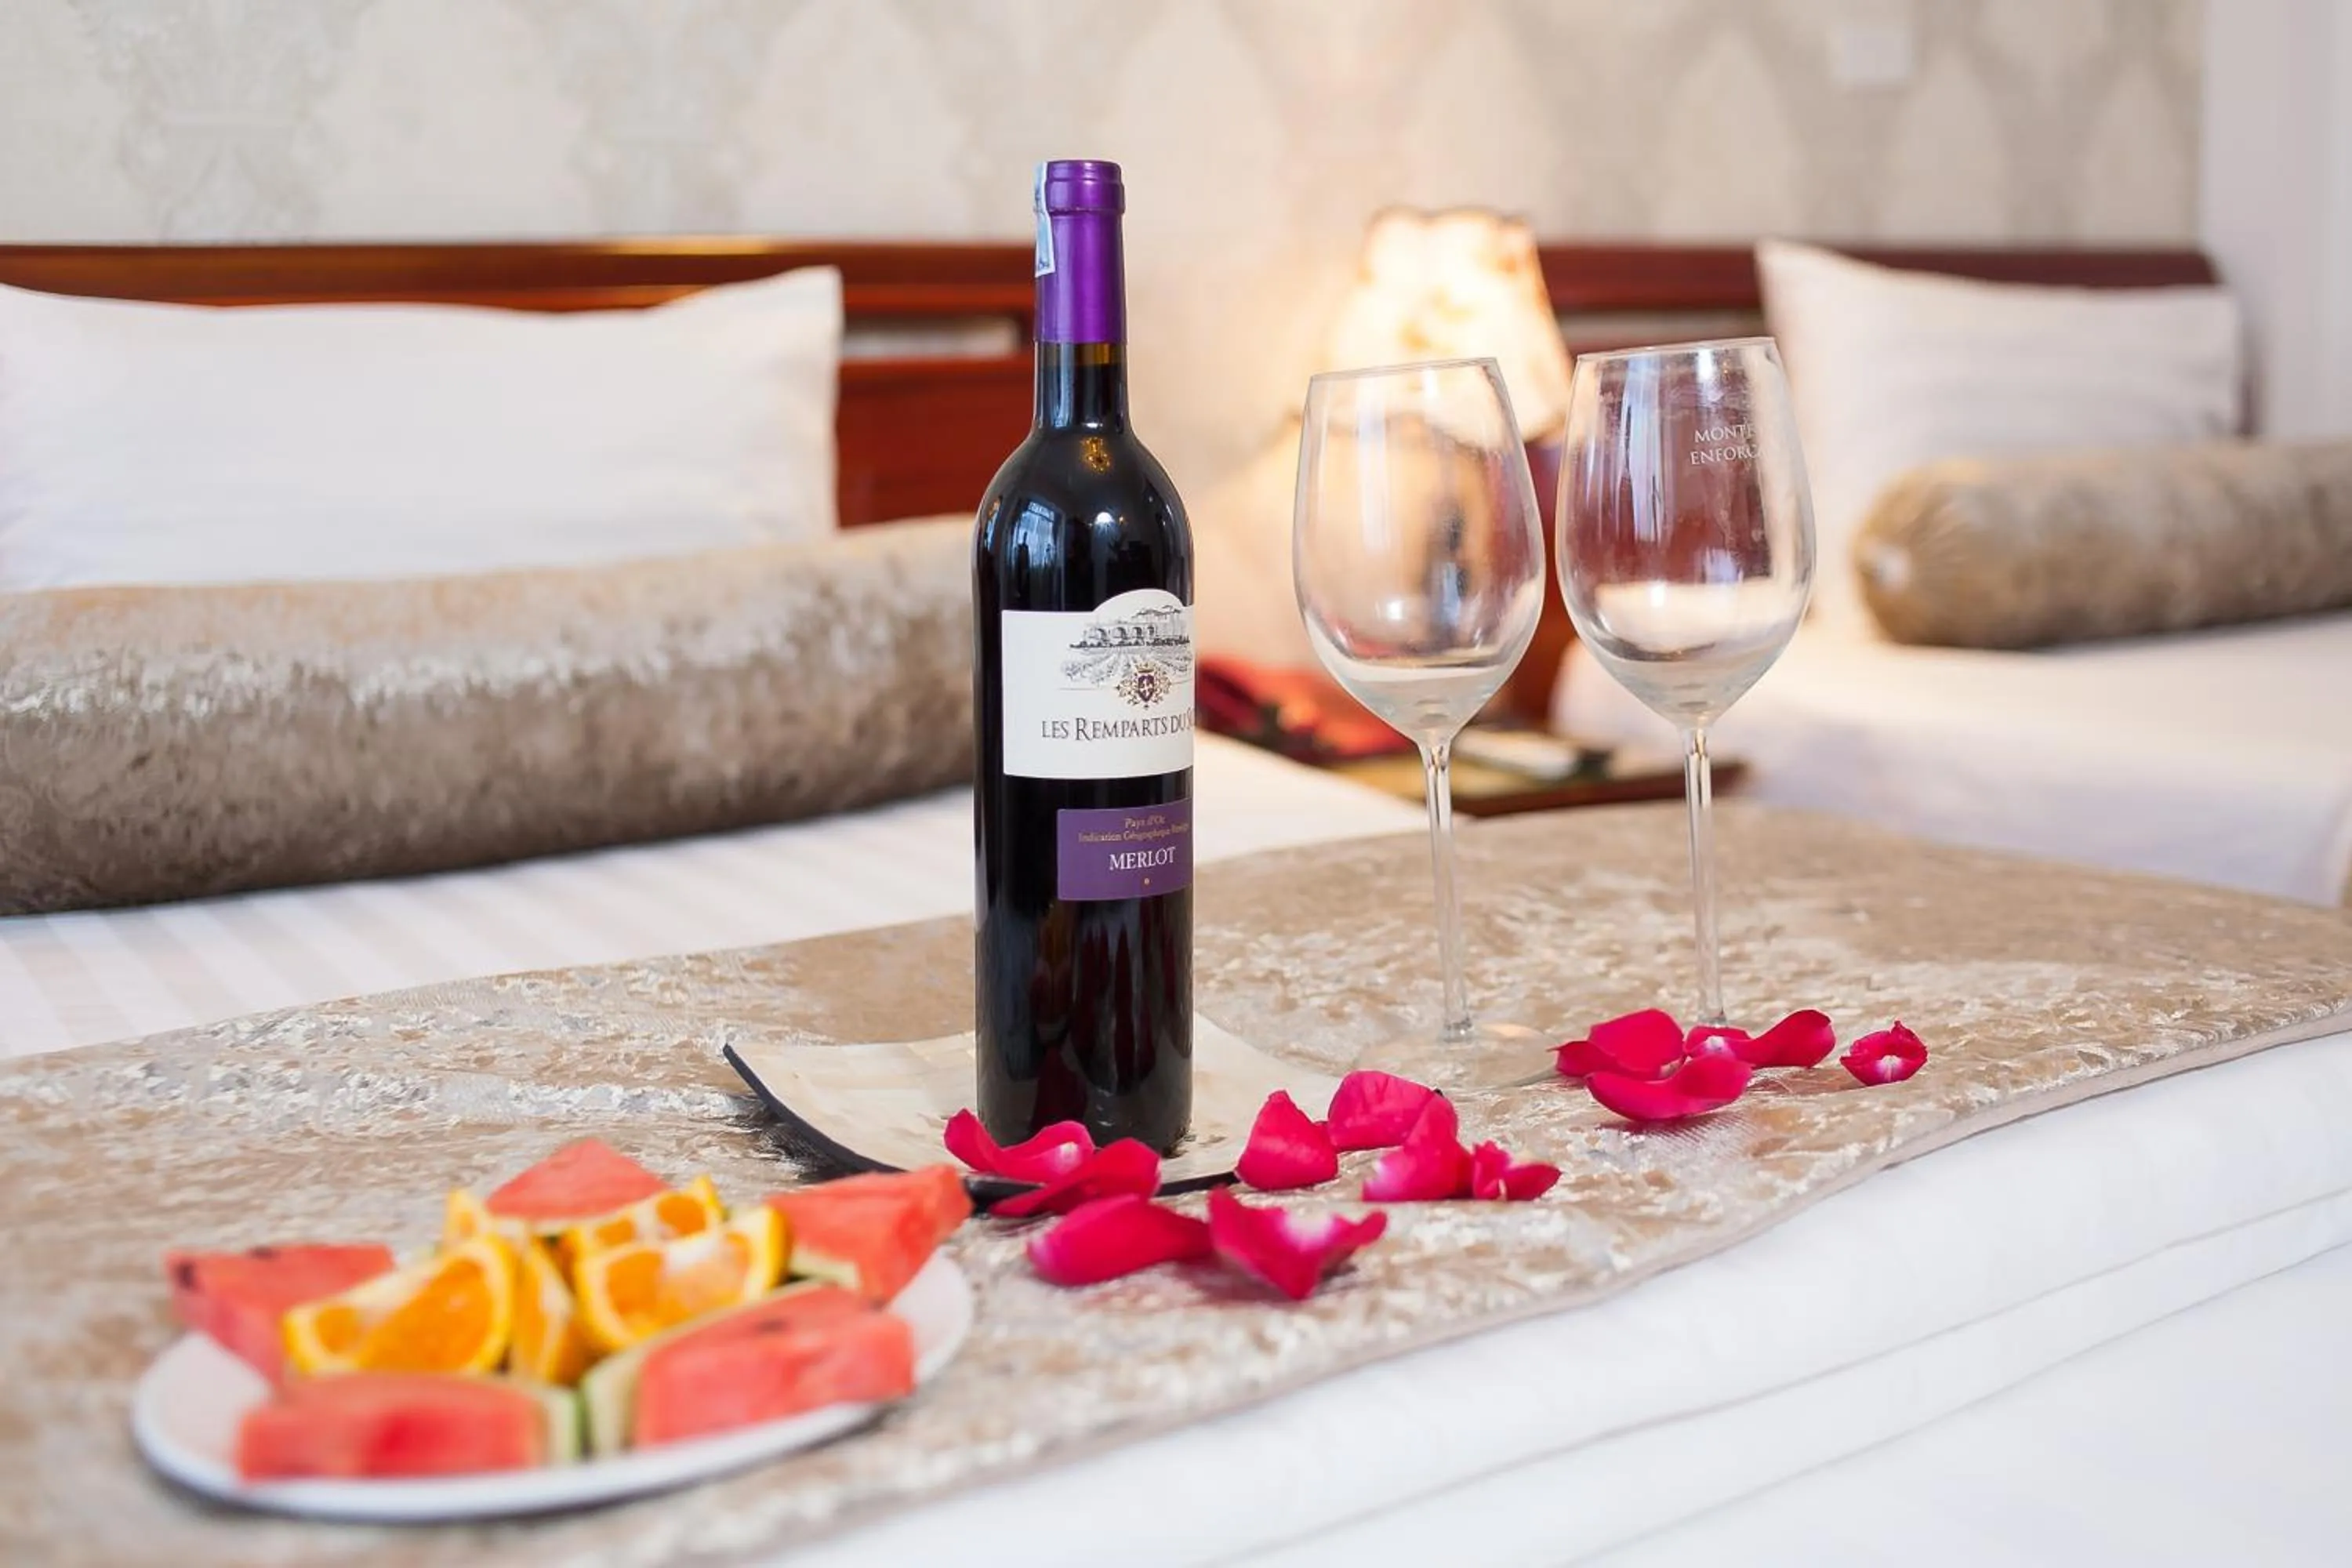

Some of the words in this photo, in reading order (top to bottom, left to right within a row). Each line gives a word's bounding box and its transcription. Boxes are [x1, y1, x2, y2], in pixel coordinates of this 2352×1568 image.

[1041, 720, 1069, 739] LES
[1075, 716, 1168, 741] REMPARTS
[1171, 713, 1186, 734] DU
[1109, 846, 1176, 870] MERLOT
